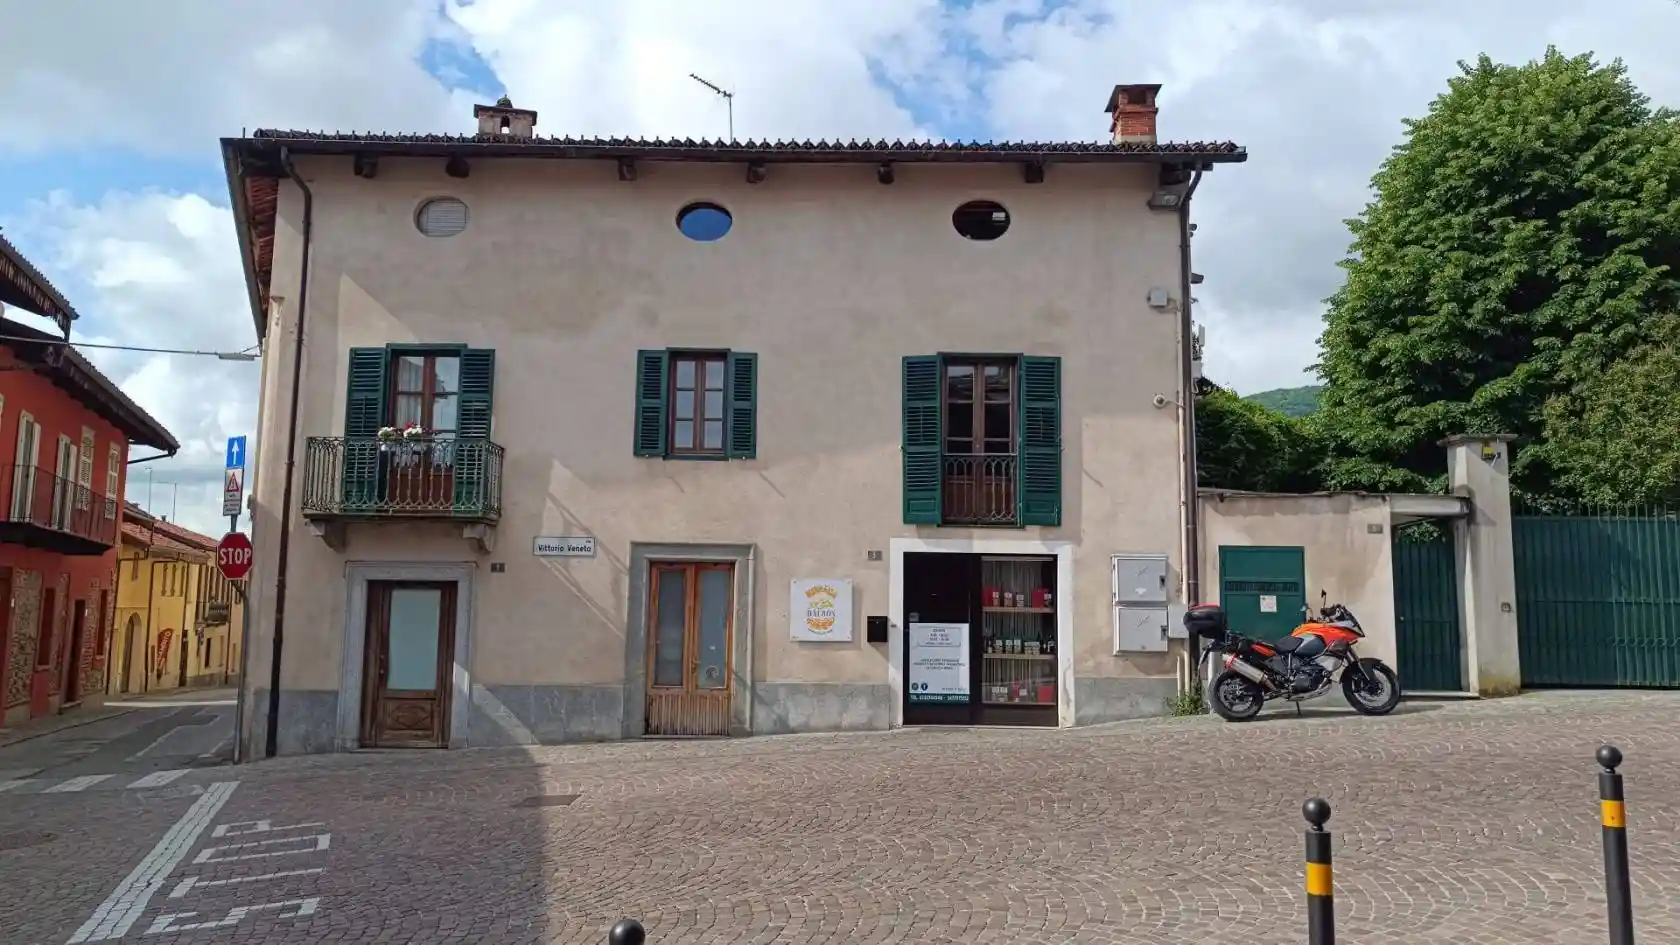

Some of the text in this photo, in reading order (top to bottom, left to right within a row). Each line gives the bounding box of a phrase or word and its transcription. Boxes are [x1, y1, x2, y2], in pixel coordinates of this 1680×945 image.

[220, 547, 252, 566] STOP
[538, 544, 591, 552] Vittorio Veneto
[143, 819, 331, 935] STOP
